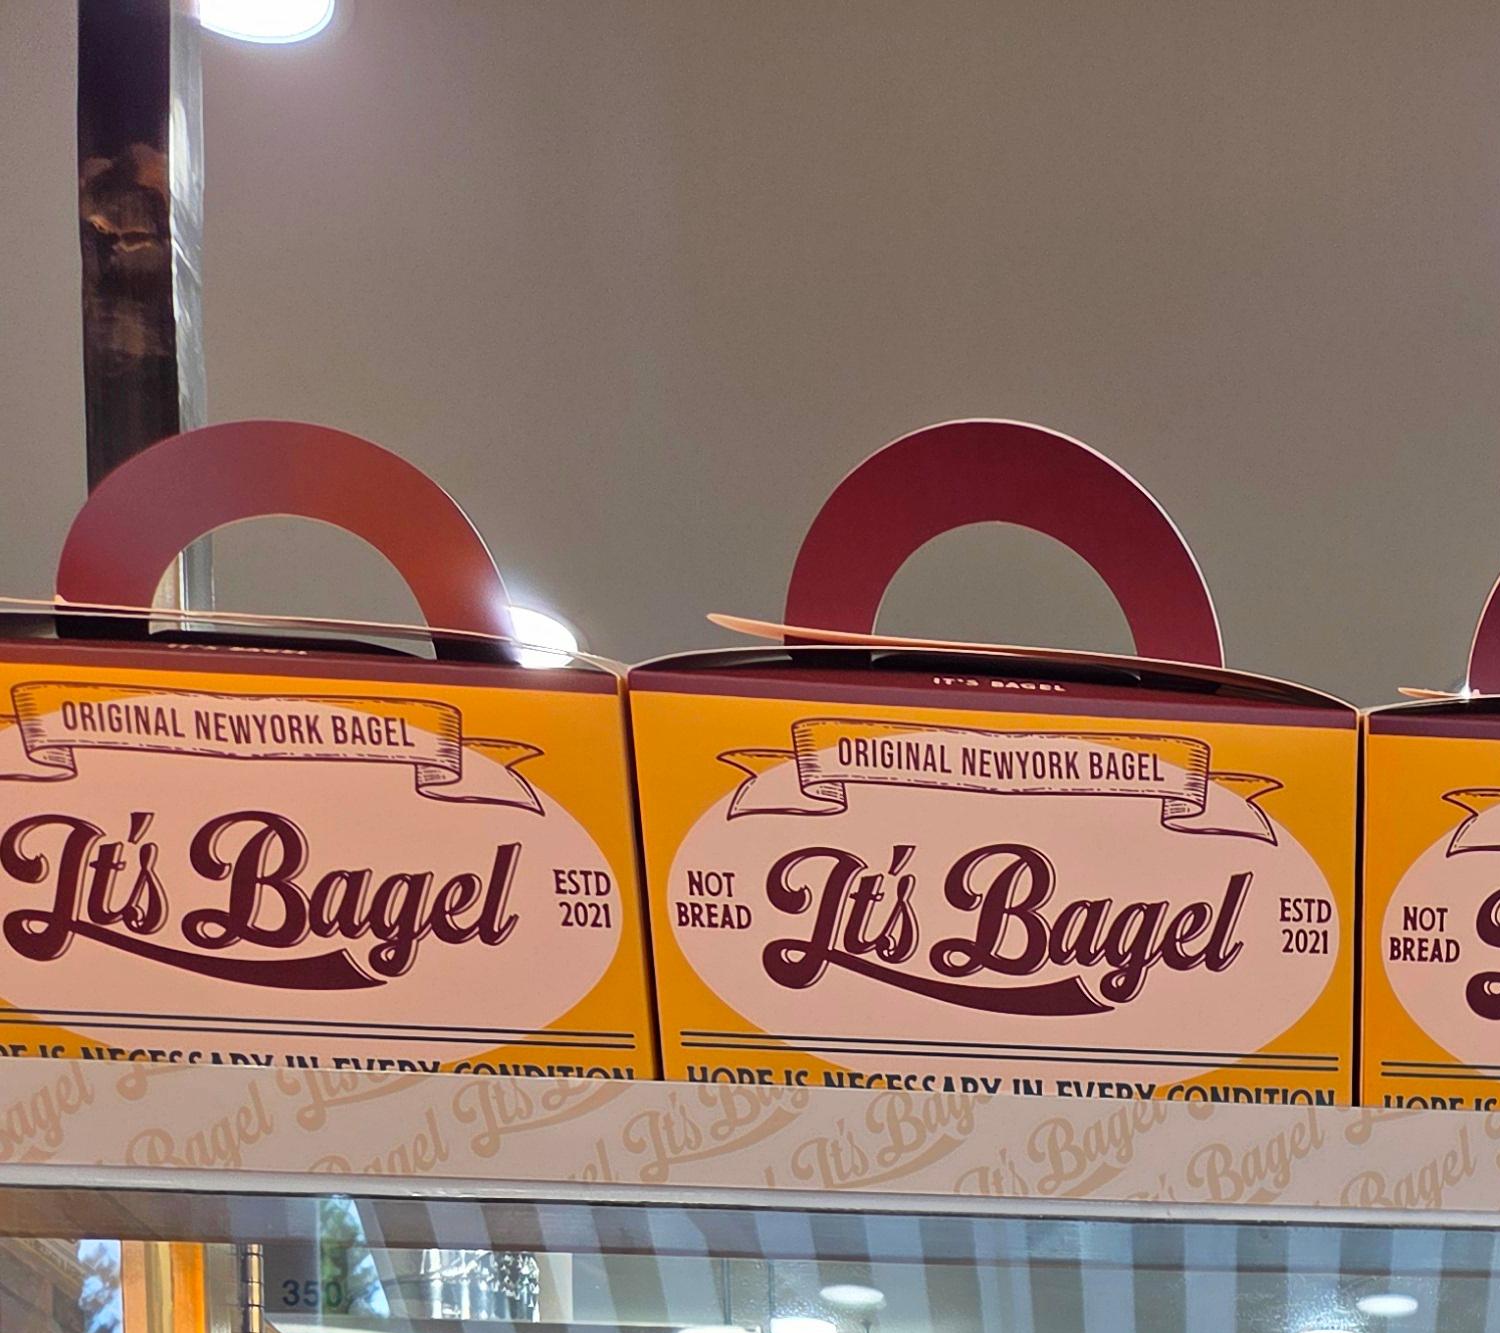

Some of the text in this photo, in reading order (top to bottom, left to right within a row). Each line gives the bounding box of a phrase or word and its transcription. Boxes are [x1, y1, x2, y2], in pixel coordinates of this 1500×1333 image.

[61, 701, 415, 749] ORIGINAL NEWYORK BAGEL
[837, 736, 1166, 784] ORIGINAL NEWYORK BAGEL
[1, 810, 520, 977] It's Bagel
[552, 867, 612, 897] ESTD
[687, 869, 736, 898] NOT
[558, 900, 613, 928] 2021
[677, 901, 753, 931] BREAD
[762, 843, 1255, 1004] It's Bagel
[1279, 896, 1332, 925] ESTD
[1402, 905, 1448, 933] NOT
[1281, 928, 1330, 955] 2021
[1389, 935, 1461, 964] BREAD
